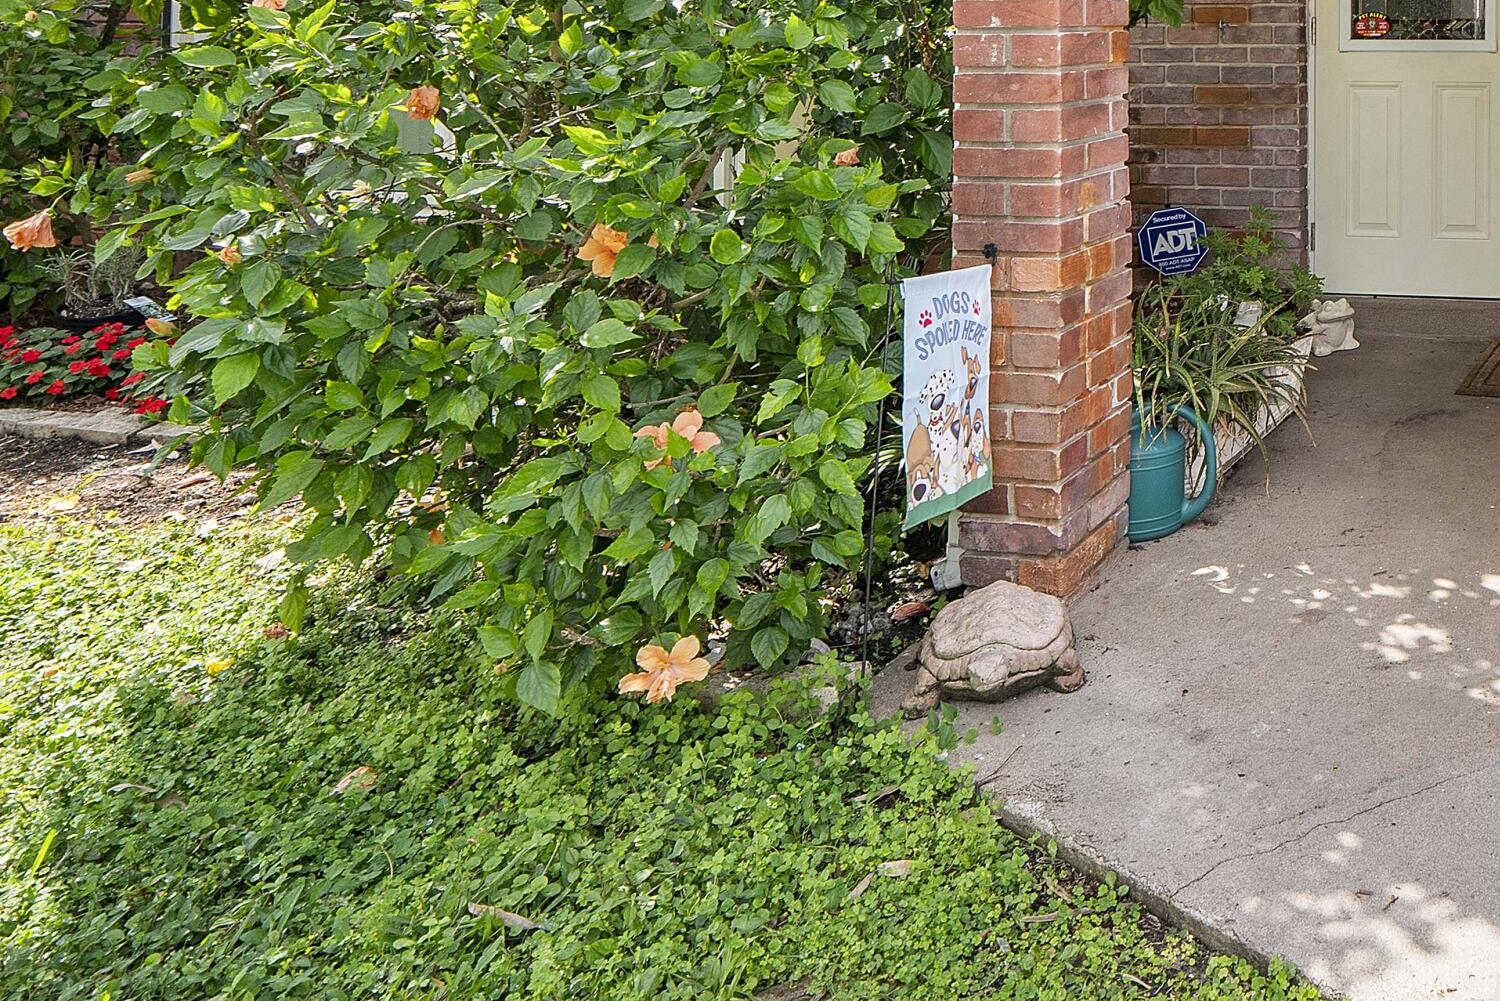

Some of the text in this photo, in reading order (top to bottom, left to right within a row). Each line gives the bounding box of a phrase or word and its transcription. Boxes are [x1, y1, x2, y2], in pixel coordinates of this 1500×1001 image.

[1153, 214, 1178, 224] Secured
[1153, 227, 1196, 256] ADT
[932, 291, 970, 320] DOGS
[914, 319, 987, 361] SPOILED HERE
